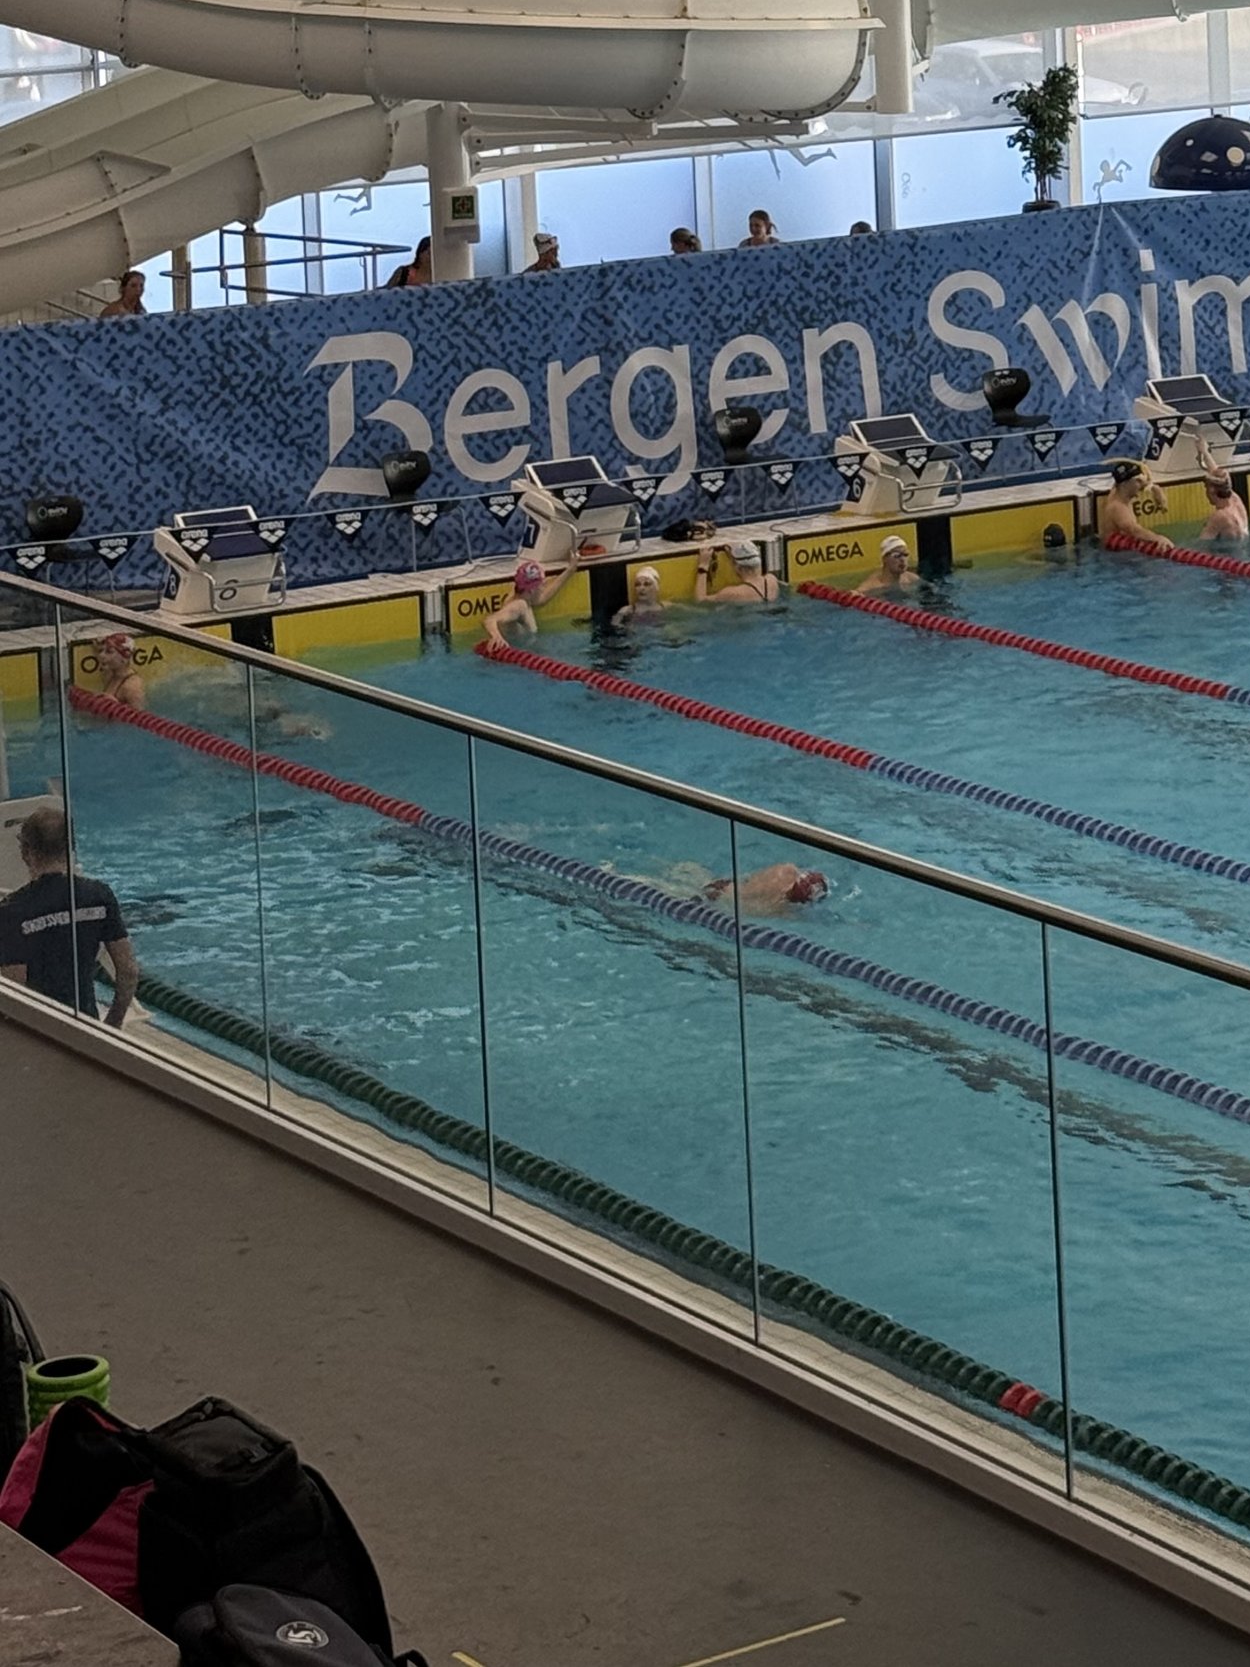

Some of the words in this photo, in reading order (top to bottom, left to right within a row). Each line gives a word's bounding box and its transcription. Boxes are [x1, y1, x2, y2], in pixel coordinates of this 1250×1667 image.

[302, 321, 882, 503] Bergen
[1151, 437, 1160, 456] 5
[852, 478, 861, 497] 6
[795, 541, 864, 566] OMEGA
[458, 593, 509, 617] OME
[81, 645, 163, 673] OGA
